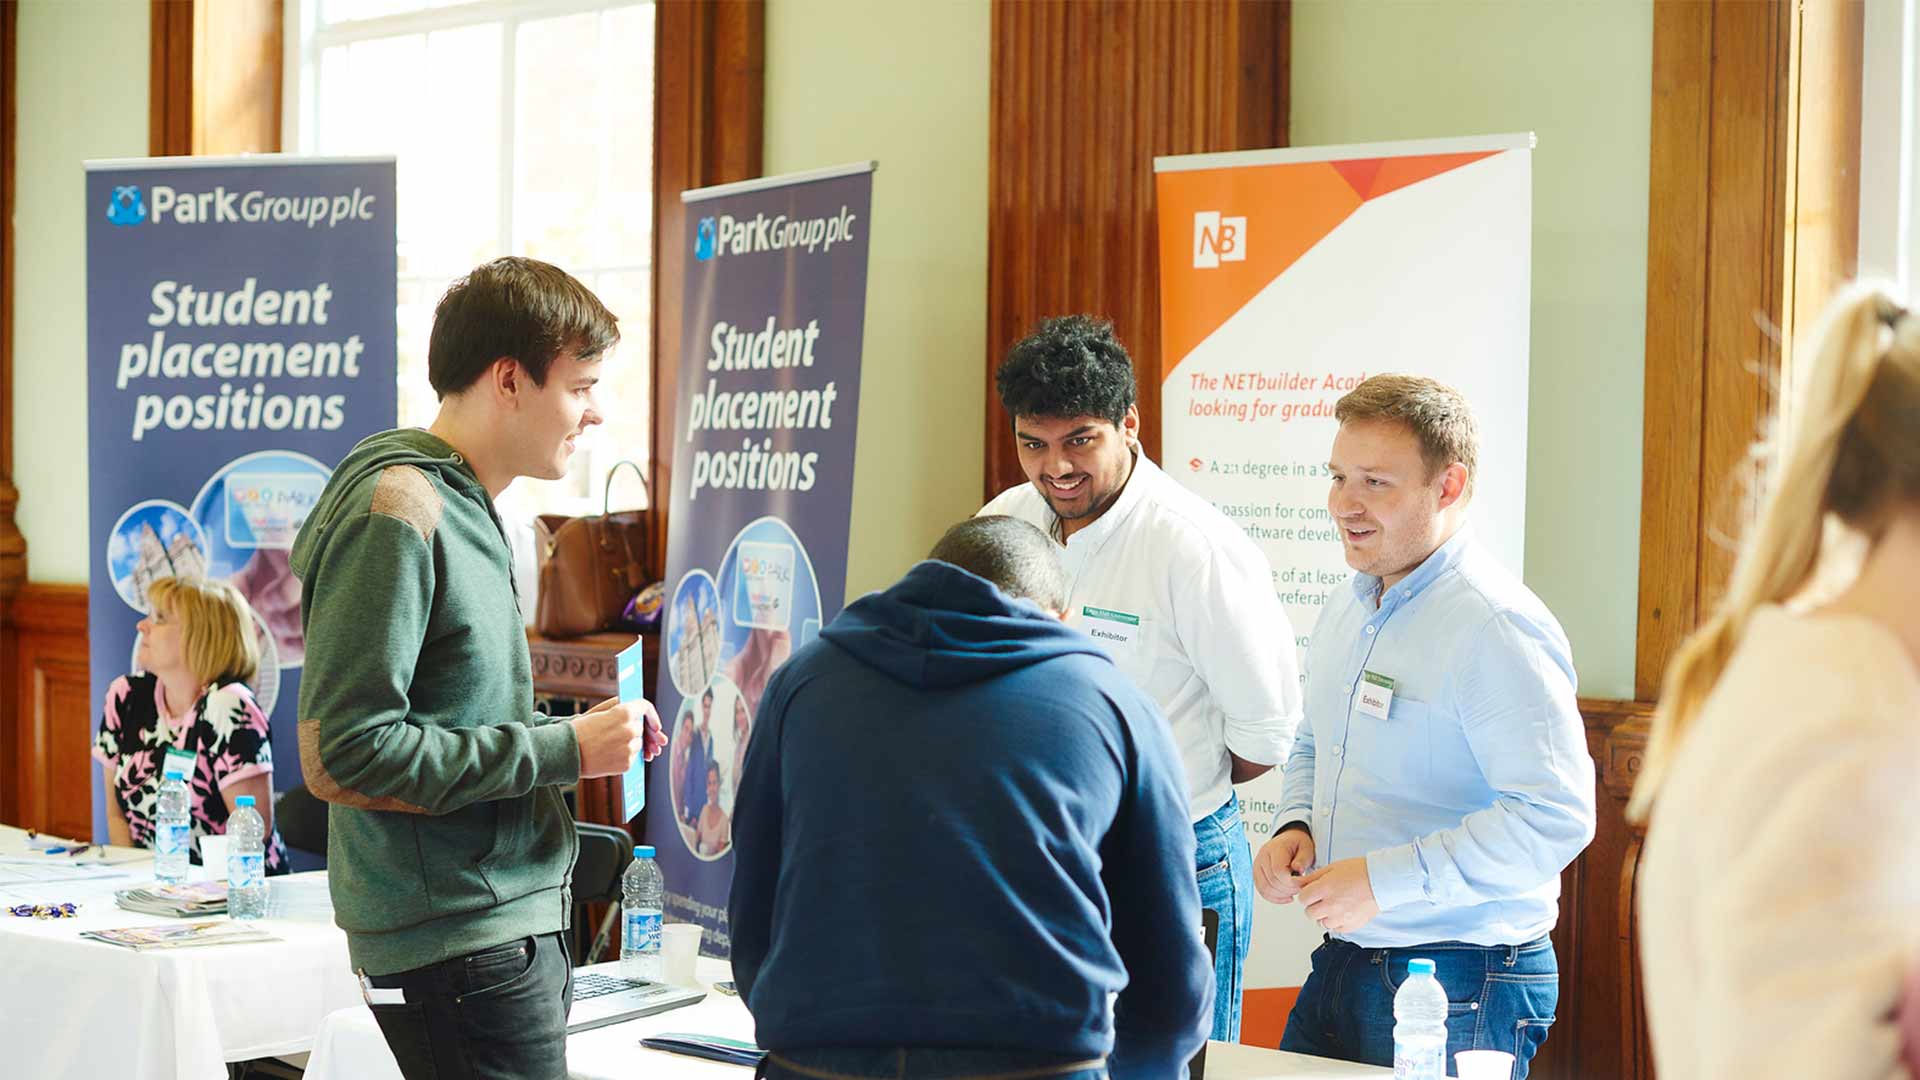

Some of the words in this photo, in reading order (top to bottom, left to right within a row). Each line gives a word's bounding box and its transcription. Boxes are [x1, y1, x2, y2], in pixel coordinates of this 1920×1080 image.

[151, 186, 239, 225] Park
[240, 191, 330, 228] Group
[330, 187, 376, 228] plc
[718, 213, 770, 256] Park
[770, 215, 824, 254] Group
[824, 205, 856, 252] plc
[1199, 224, 1236, 256] NB
[147, 277, 334, 327] Student
[116, 331, 365, 390] placement
[707, 316, 820, 372] Student
[1190, 373, 1218, 391] The
[1222, 373, 1318, 391] NETbuilder
[132, 383, 346, 441] positions
[686, 378, 838, 443] placement
[1189, 399, 1248, 422] looking
[1250, 398, 1277, 422] for
[690, 437, 818, 500] positions
[1211, 461, 1219, 474] A
[1223, 463, 1239, 474] 2:1
[1243, 460, 1288, 479] degree
[1292, 461, 1305, 475] in
[1309, 465, 1317, 476] a
[1275, 502, 1295, 518] for
[1281, 567, 1296, 582] of
[1299, 571, 1312, 584] at
[1091, 628, 1128, 642] Exhibitor
[1250, 797, 1279, 814] inte
